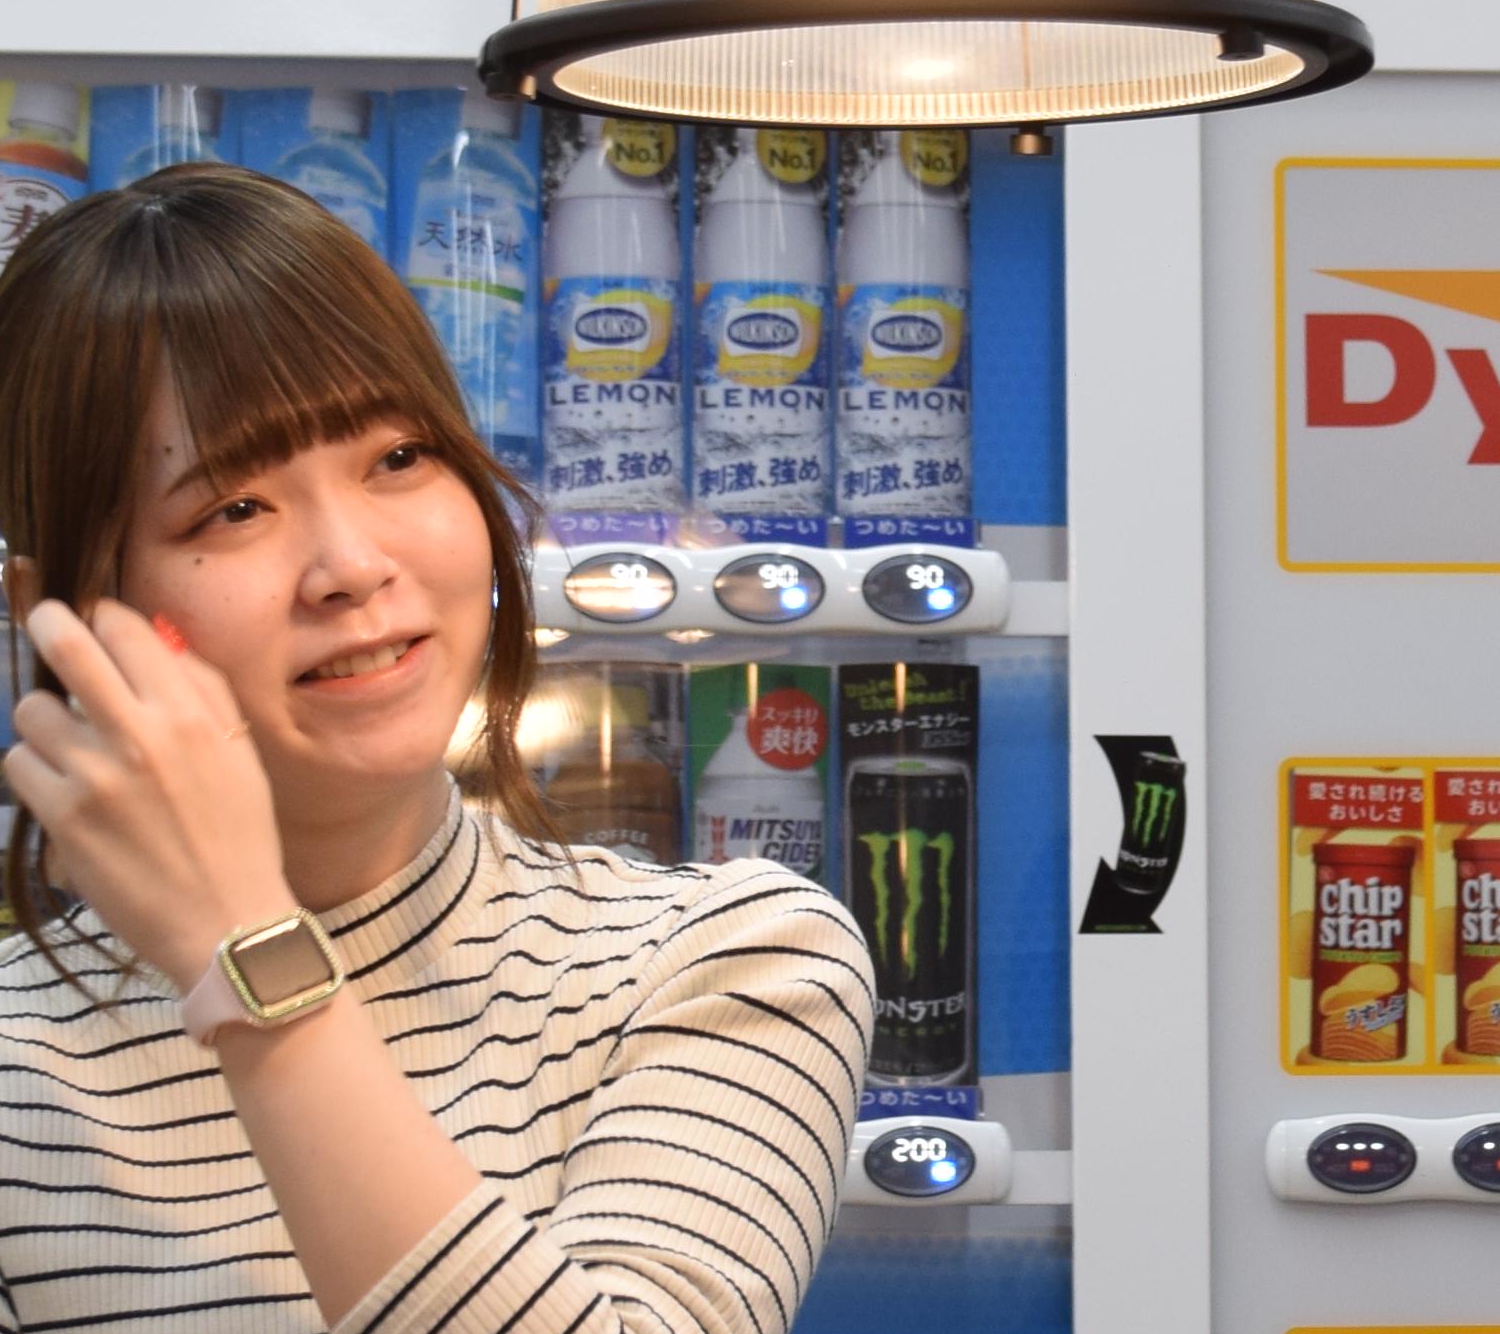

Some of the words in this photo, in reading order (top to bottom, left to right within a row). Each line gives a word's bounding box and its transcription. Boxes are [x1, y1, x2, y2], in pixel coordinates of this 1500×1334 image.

[551, 384, 676, 406] LEMON
[700, 388, 825, 411] LEMON
[843, 391, 967, 413] LEMON
[551, 450, 673, 492] 刺激、強め
[698, 455, 821, 499] 刺激、強め
[843, 458, 963, 500] 刺激、強め
[759, 564, 799, 589] 90
[906, 564, 945, 589] 90
[847, 713, 971, 737] モンスターエナジー
[760, 726, 819, 756] 爽快
[1308, 781, 1424, 803] 愛され続ける
[1329, 804, 1403, 822] おいしさ
[584, 828, 648, 845] COFFEE
[1320, 876, 1404, 918] chip
[1319, 913, 1404, 951] star
[891, 1136, 948, 1163] 200
